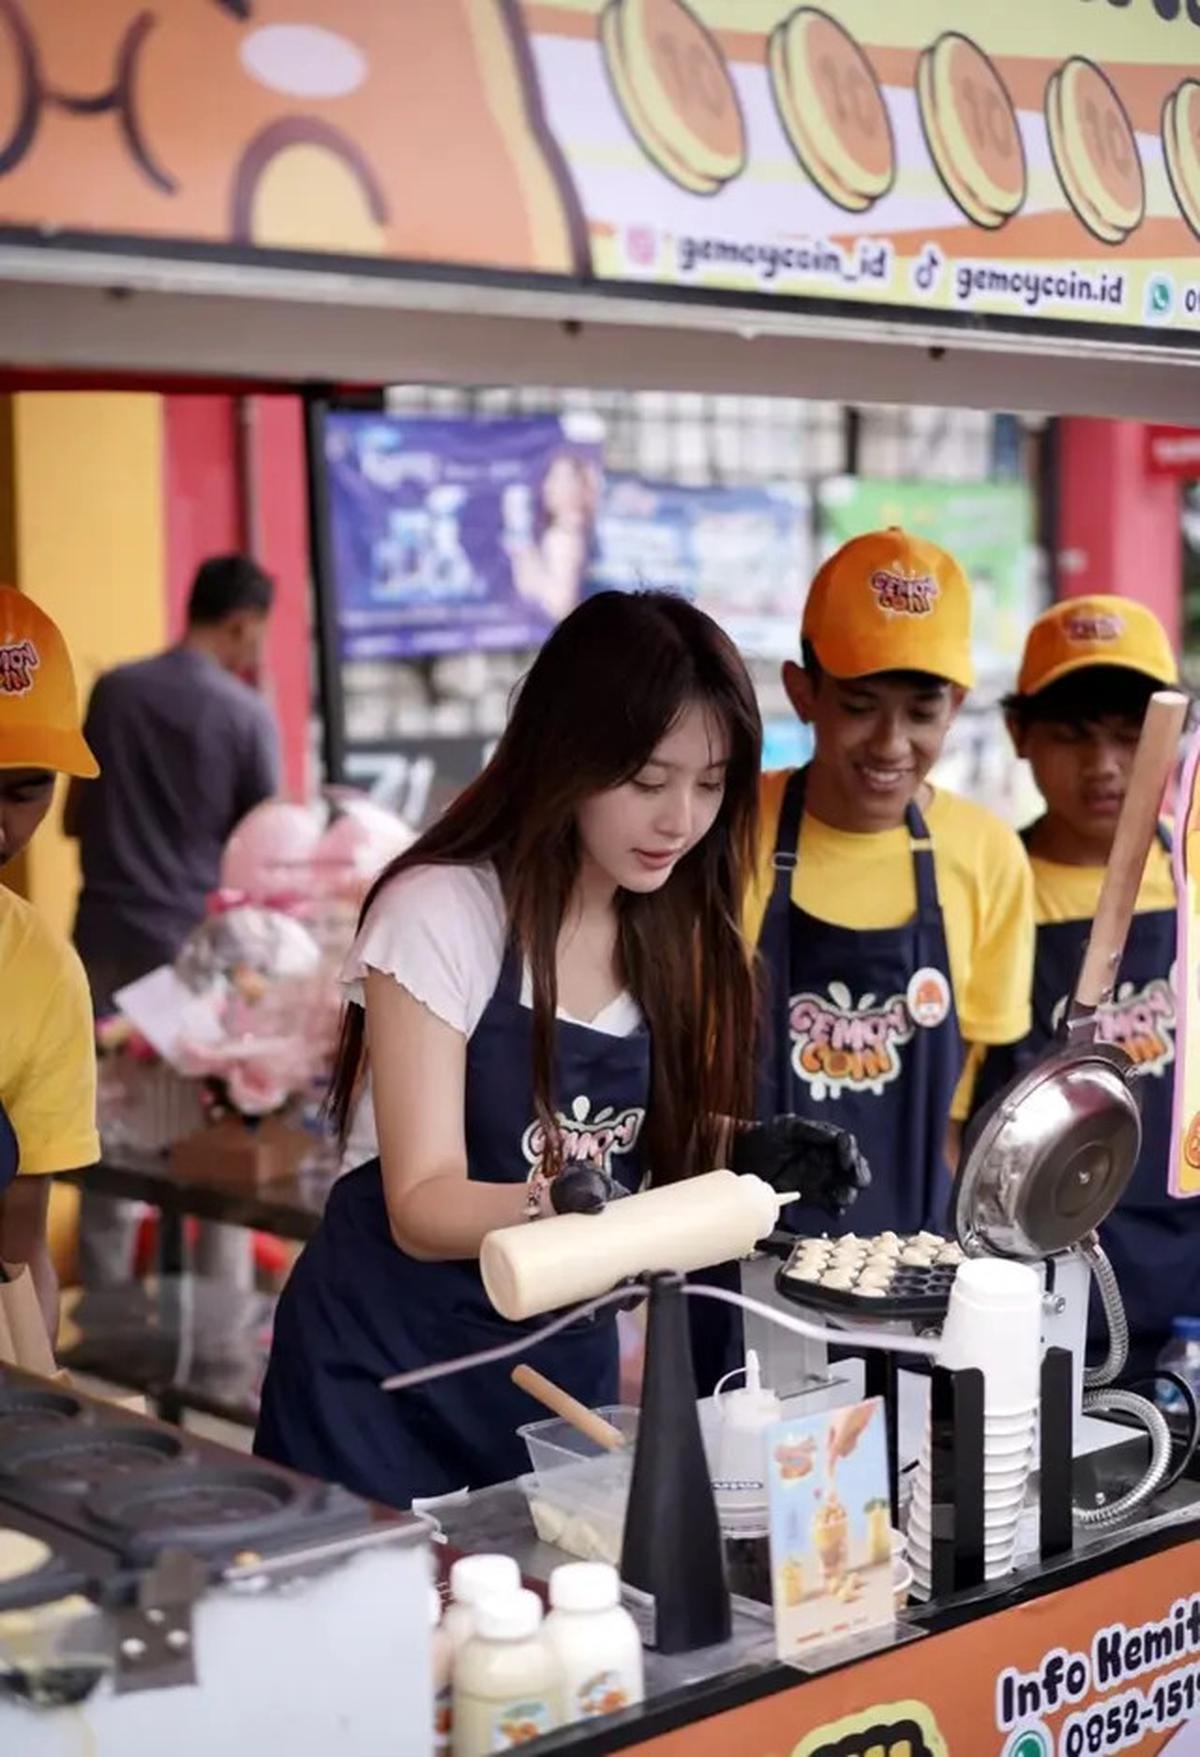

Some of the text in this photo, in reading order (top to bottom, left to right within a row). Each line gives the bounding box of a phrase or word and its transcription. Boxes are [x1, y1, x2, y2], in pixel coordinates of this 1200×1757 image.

[957, 267, 1122, 306] gemoycoin.id
[789, 1000, 908, 1050] GEMOY
[801, 1041, 892, 1080] COIN
[529, 1114, 636, 1160] GMOY
[1002, 1655, 1087, 1724] Info
[1066, 1672, 1200, 1757] 0852-151
